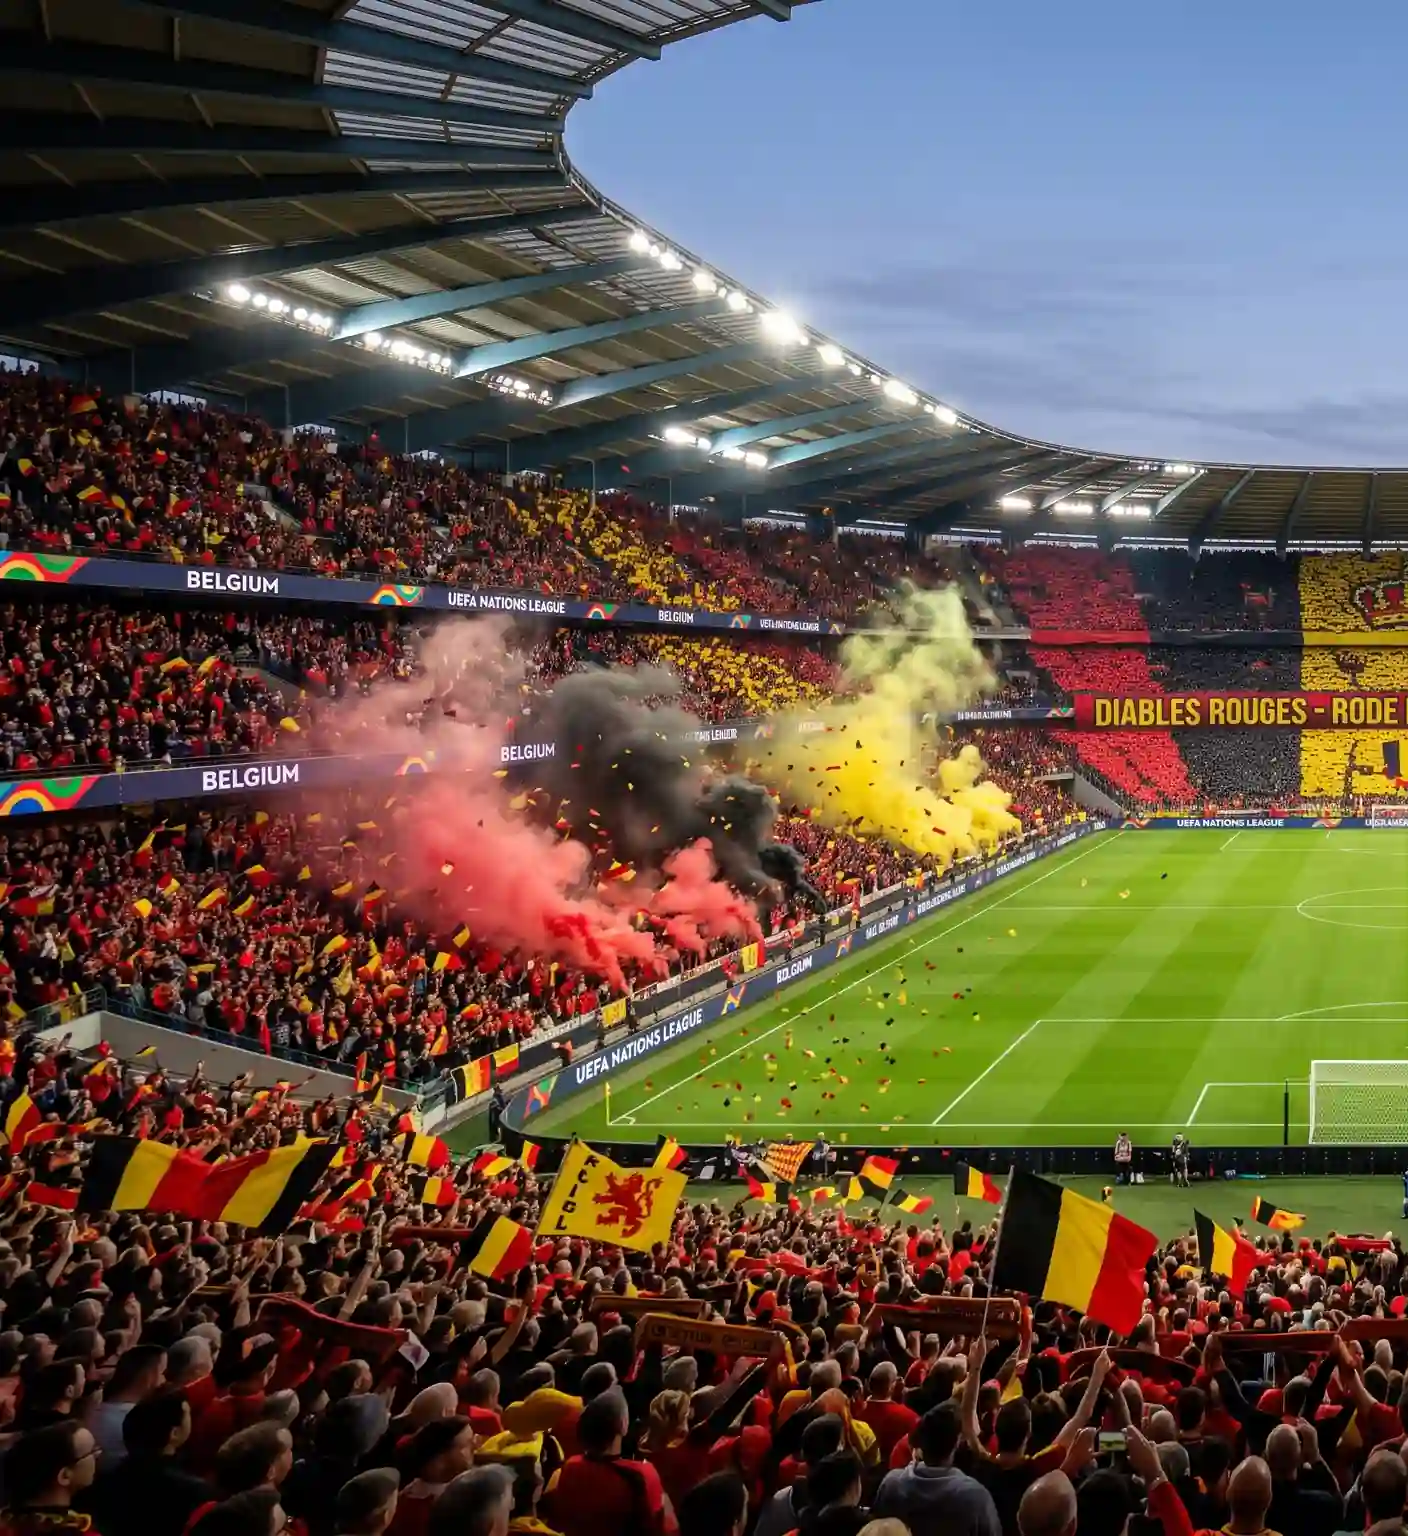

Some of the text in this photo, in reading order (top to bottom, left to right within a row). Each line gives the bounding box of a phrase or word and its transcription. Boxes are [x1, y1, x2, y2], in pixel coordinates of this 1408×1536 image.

[187, 570, 279, 594] BELGIUM
[448, 591, 566, 614] UEFA NATIONS LEAGUE
[658, 610, 694, 624] BELGIUM
[1095, 698, 1200, 726] DIABLES
[1209, 697, 1308, 725] ROUGES
[1332, 697, 1399, 725] RODE
[501, 743, 555, 762] BELGIUM
[203, 763, 299, 791] BELGIUM
[1176, 818, 1284, 827] UEFA NATIONS LEAGUE
[576, 1008, 703, 1084] UEFA NATIONS LEAGUE
